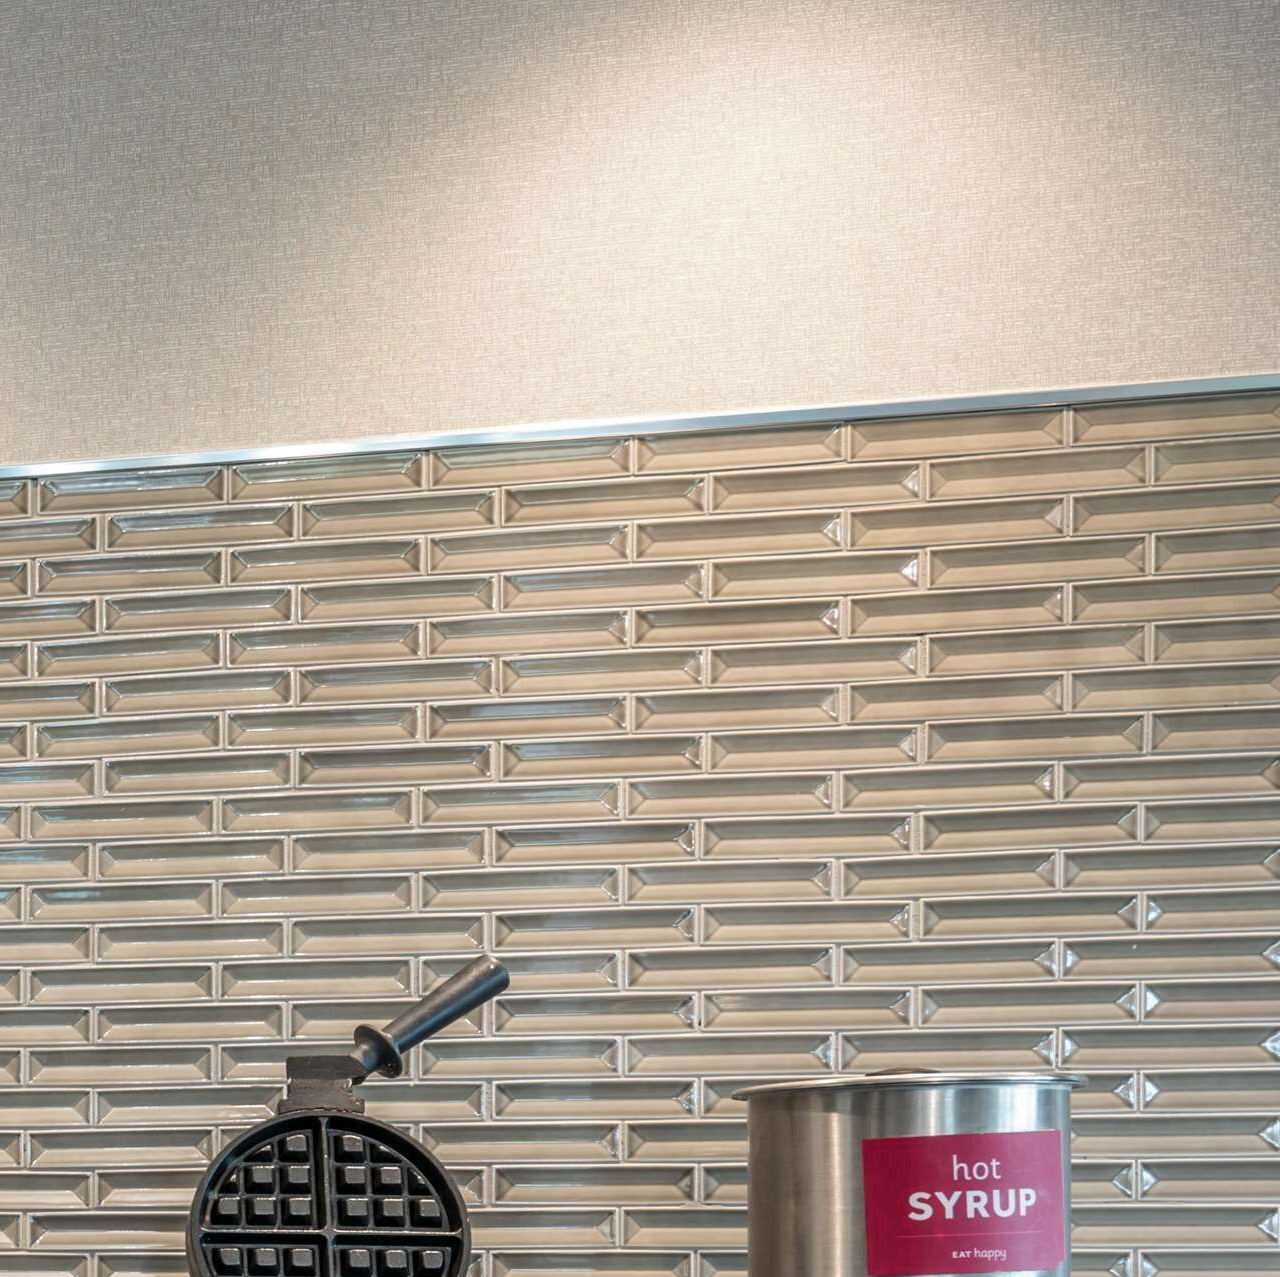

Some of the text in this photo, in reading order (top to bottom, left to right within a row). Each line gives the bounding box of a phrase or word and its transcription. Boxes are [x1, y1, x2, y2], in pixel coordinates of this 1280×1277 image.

[952, 1154, 1002, 1181] hot
[908, 1188, 1037, 1221] SYRUP
[974, 1247, 1007, 1261] happy
